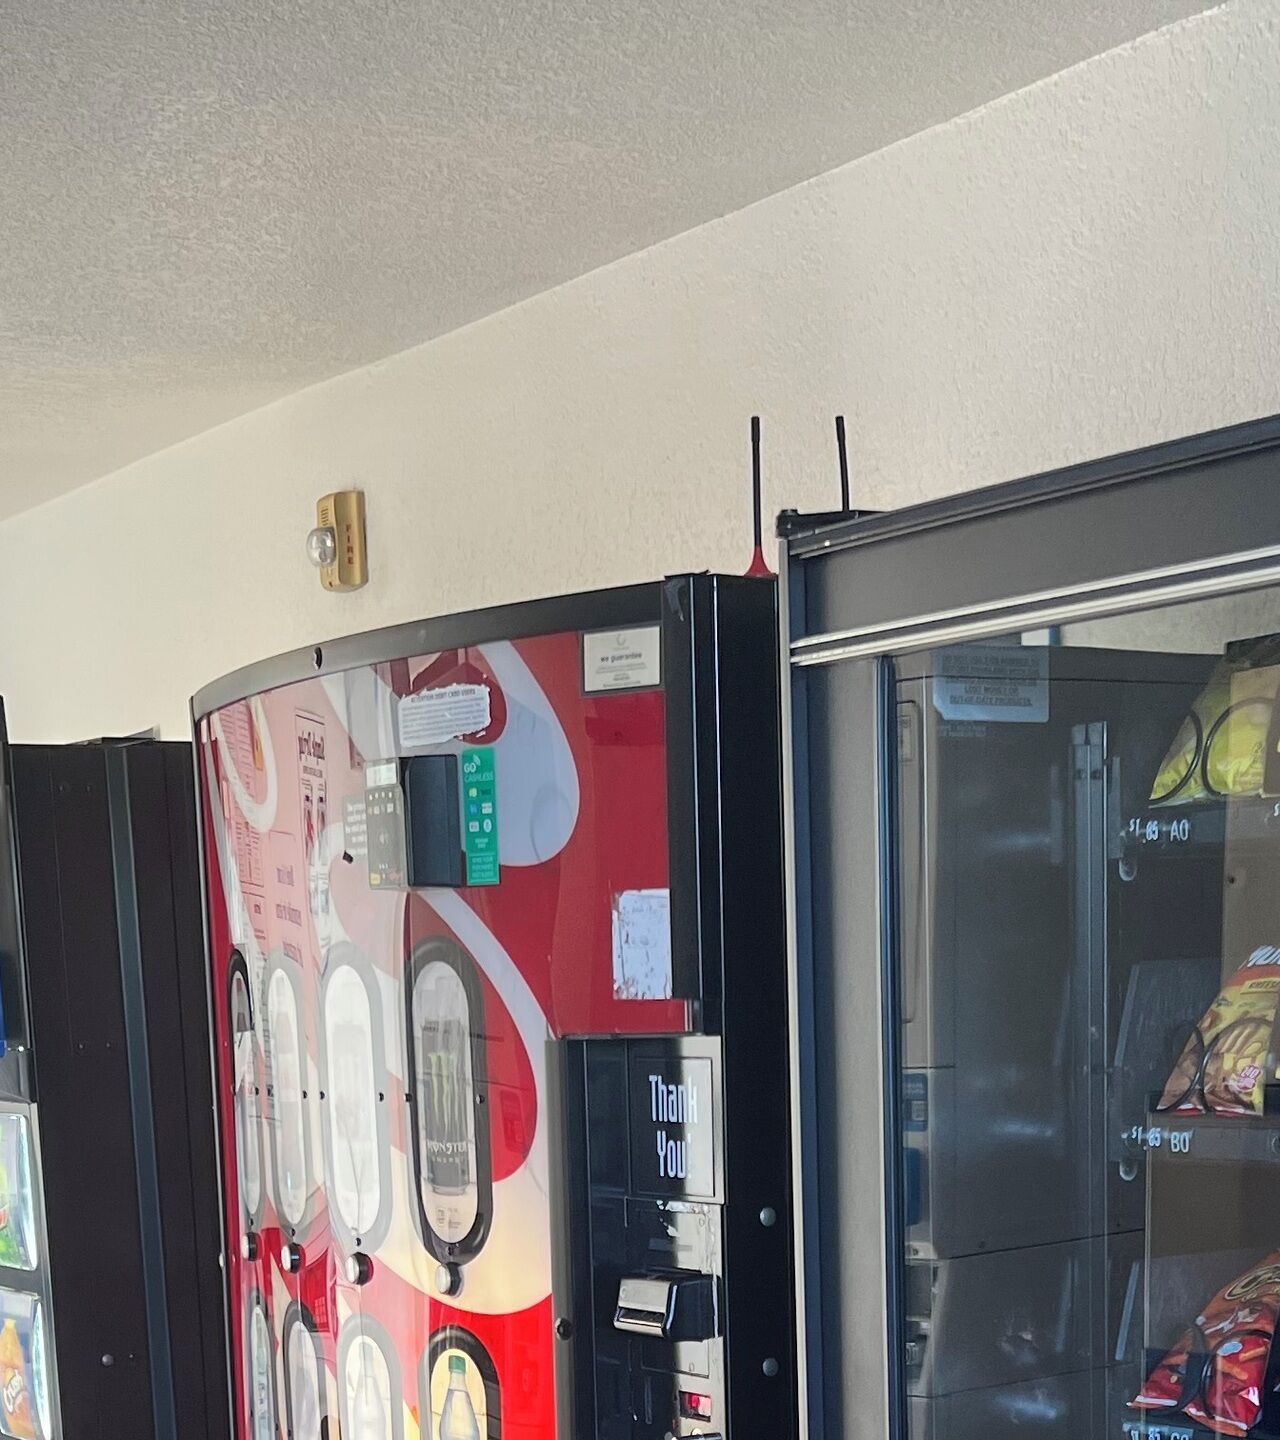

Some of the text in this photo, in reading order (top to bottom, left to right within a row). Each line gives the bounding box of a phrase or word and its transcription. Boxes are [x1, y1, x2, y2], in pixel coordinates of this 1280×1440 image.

[463, 763, 476, 773] GO
[1170, 820, 1189, 840] A0
[648, 1074, 698, 1125] Thank
[1170, 1134, 1189, 1153] B0
